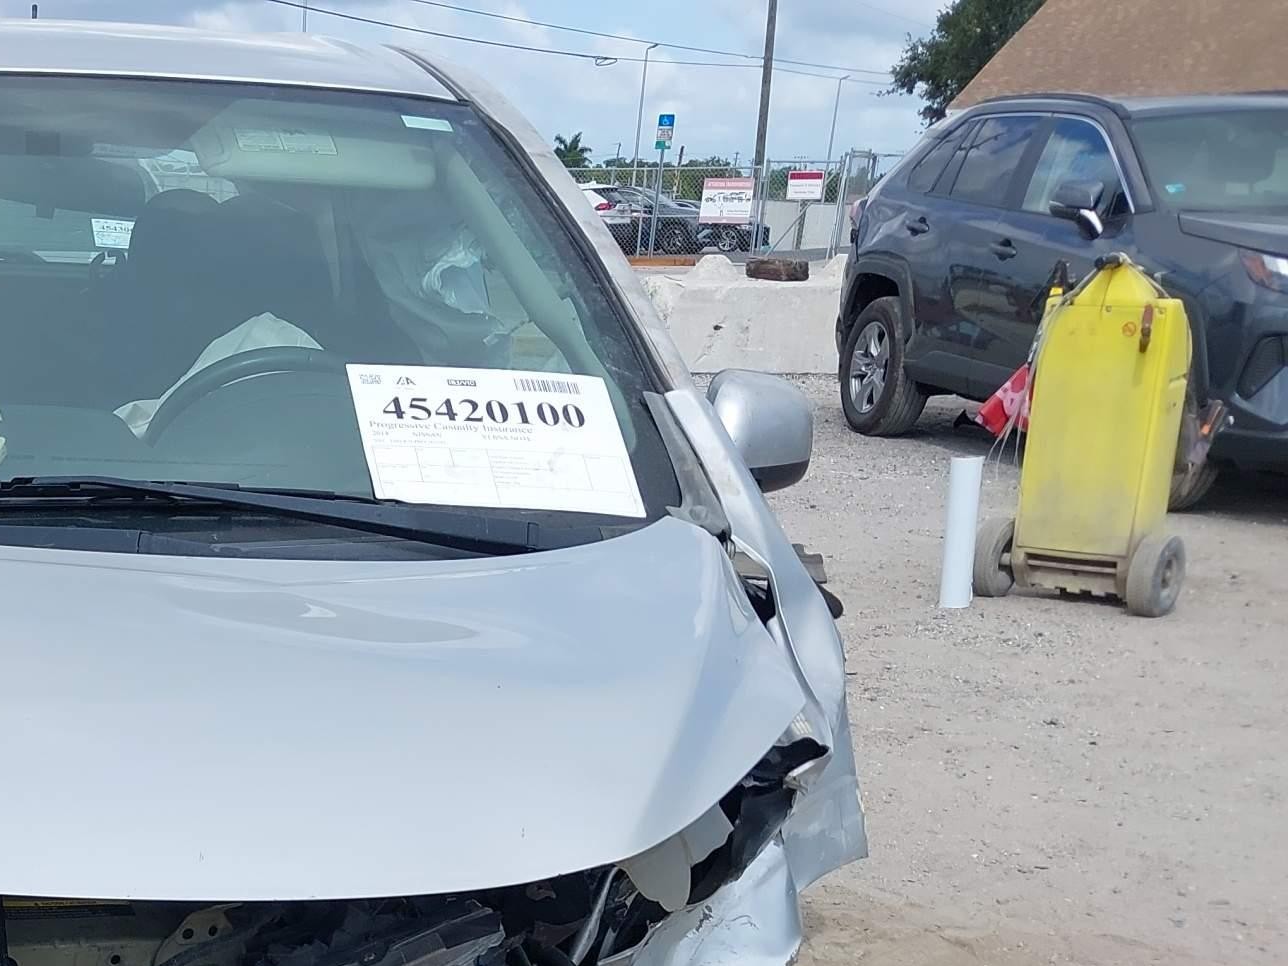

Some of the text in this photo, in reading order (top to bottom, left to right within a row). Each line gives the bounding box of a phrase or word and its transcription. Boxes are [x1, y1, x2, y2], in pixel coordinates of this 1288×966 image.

[383, 396, 585, 428] 45420100
[369, 421, 533, 433] Progressive Casualty Insurance
